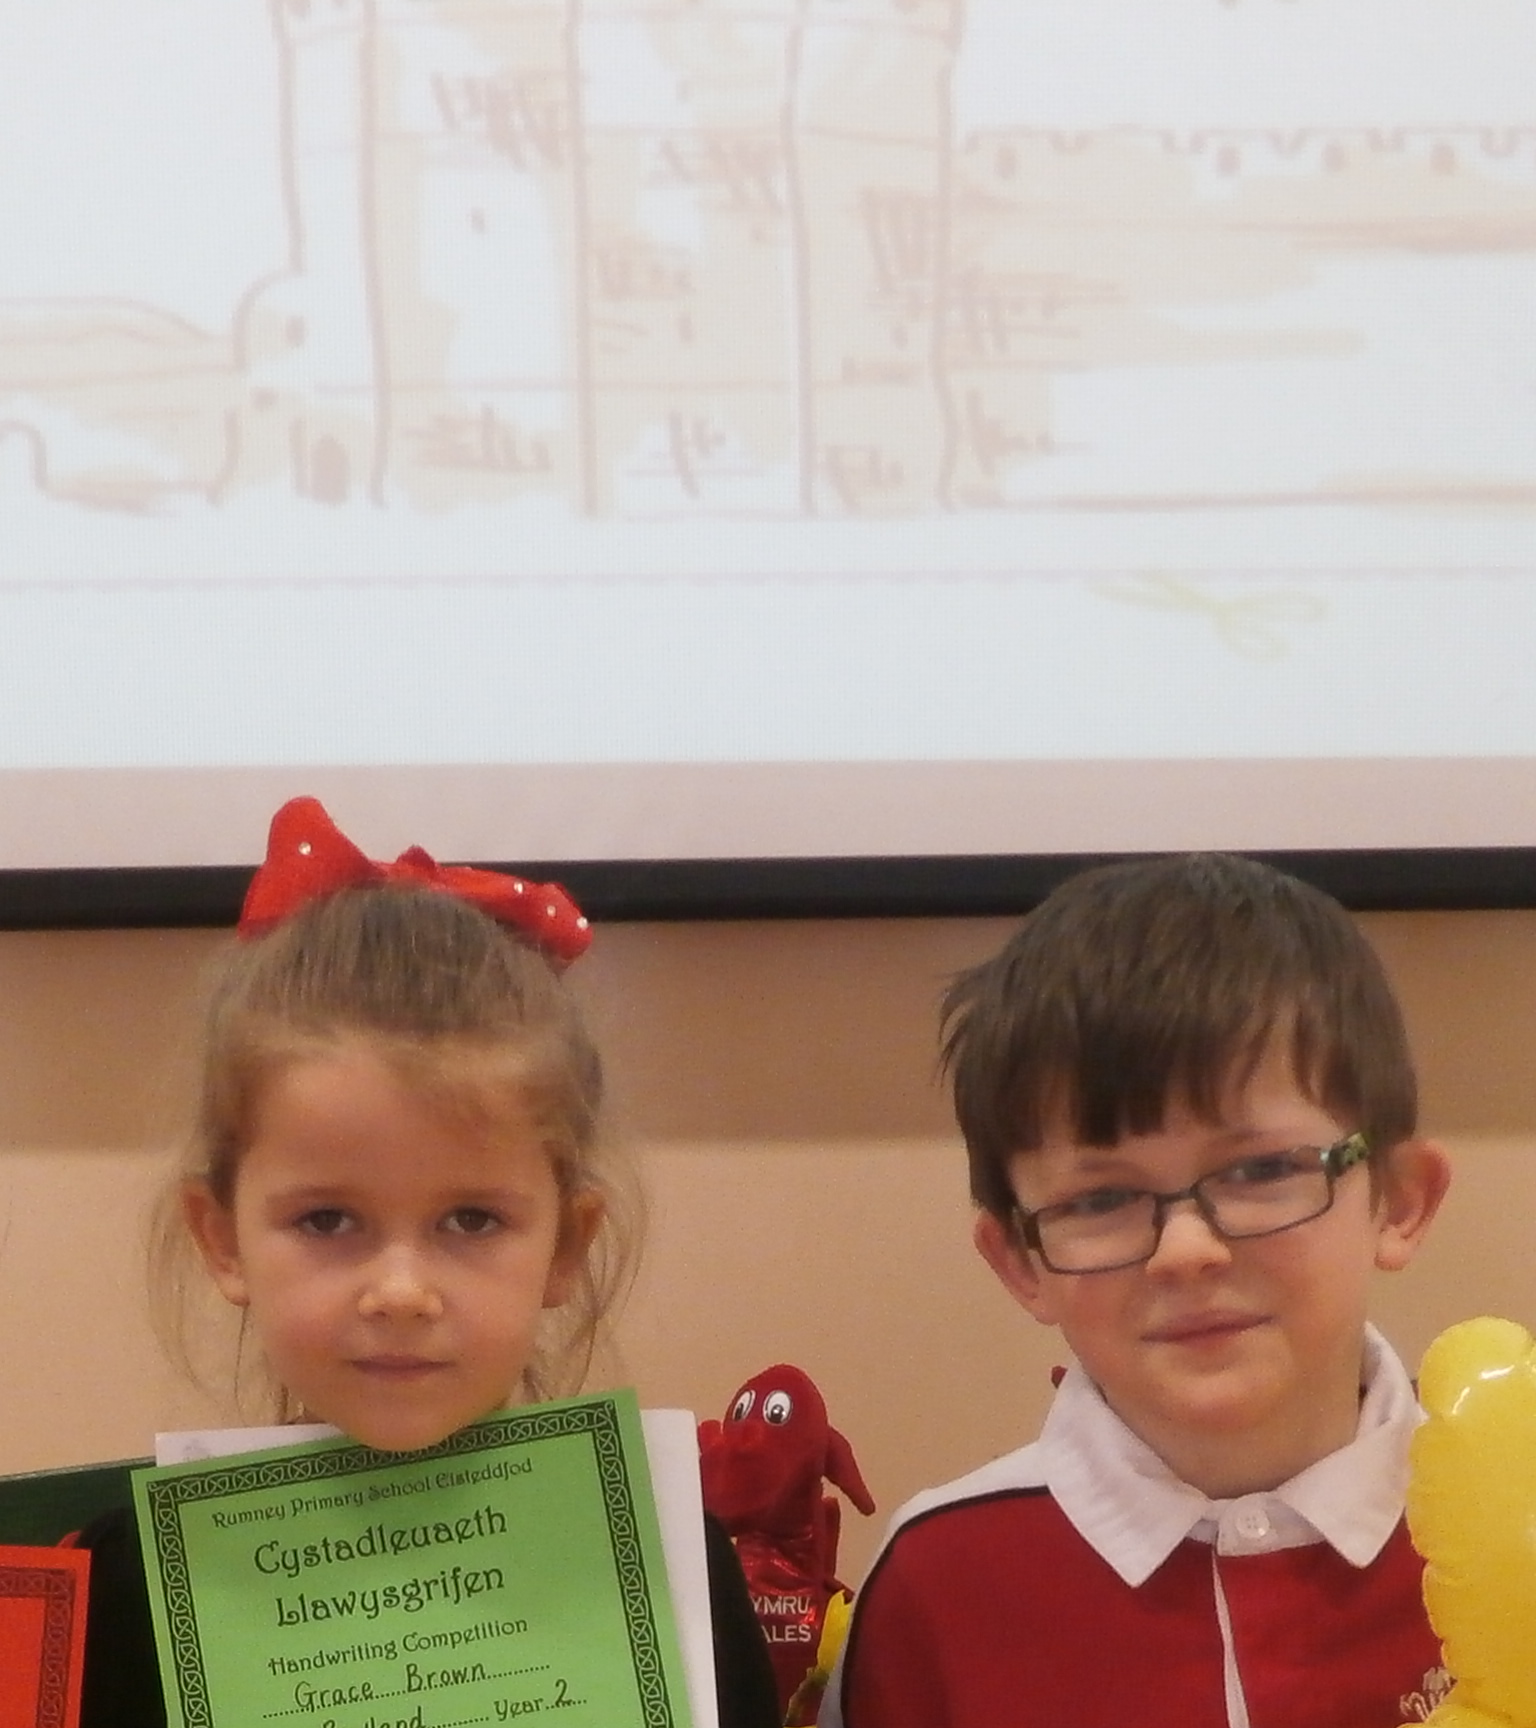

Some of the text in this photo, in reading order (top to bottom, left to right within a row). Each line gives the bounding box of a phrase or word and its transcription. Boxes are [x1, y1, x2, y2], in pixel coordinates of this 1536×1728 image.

[212, 1457, 532, 1528] Rumney Primary School Eisteddfod
[254, 1505, 508, 1577] Cystadleuaeth
[276, 1566, 505, 1627] Llawysgrifen
[750, 1595, 810, 1615] YMRU
[268, 1618, 528, 1677] Handwriting Competition
[760, 1623, 812, 1643] LES
[294, 1662, 488, 1713] Grace Brown
[493, 1696, 544, 1722] Year
[554, 1678, 573, 1707] 2
